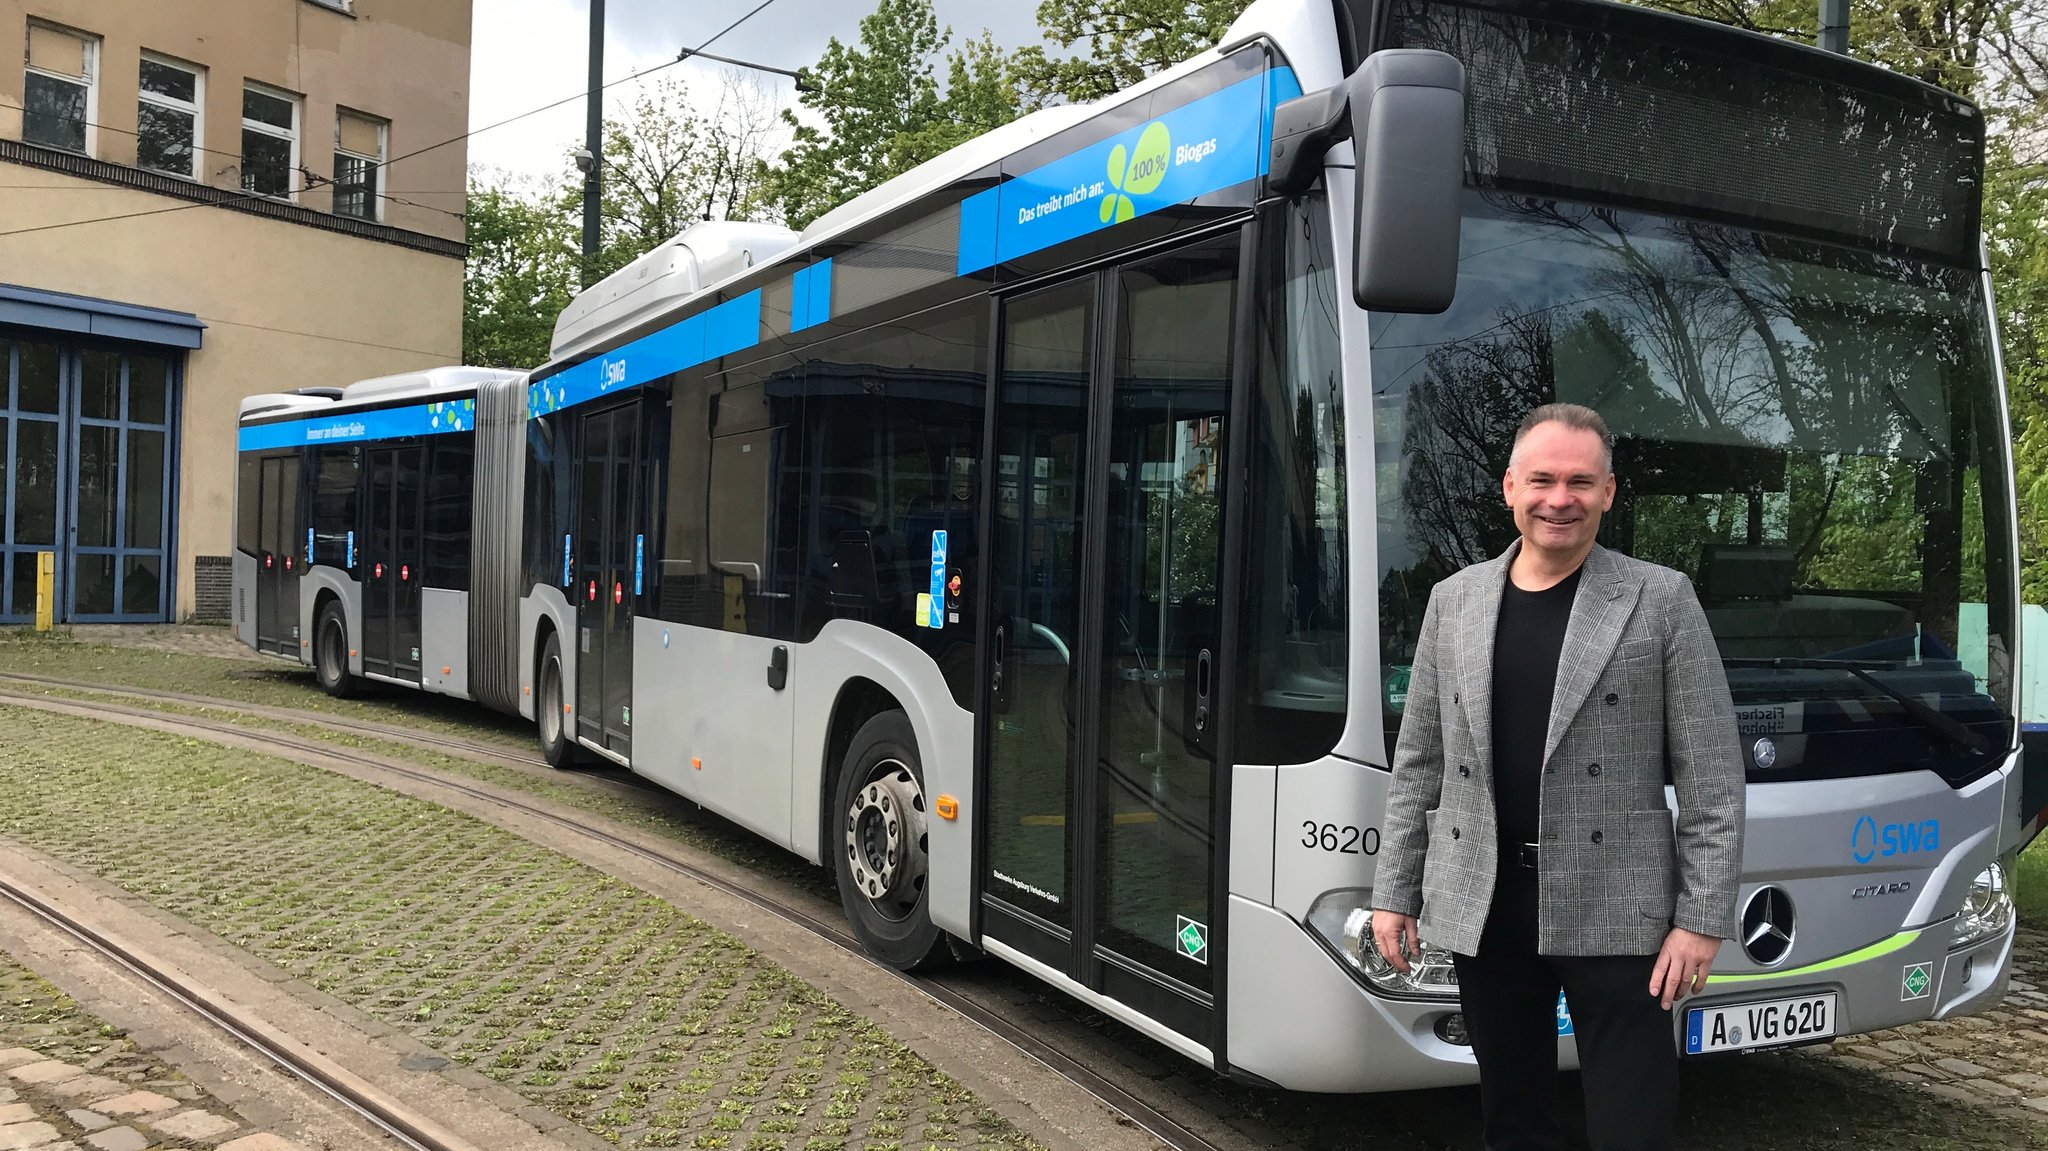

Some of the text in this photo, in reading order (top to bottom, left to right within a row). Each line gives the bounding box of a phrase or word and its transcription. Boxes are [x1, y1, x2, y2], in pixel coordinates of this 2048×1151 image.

[1132, 152, 1166, 181] 100 %
[1175, 138, 1217, 167] Biogas
[1018, 181, 1105, 225] Das treibt mich an:
[607, 359, 626, 386] swa
[306, 422, 366, 440] Immer an deiner Seite
[1397, 676, 1406, 693] 4
[1301, 820, 1381, 856] 3620
[1880, 818, 1940, 858] swa
[993, 869, 1060, 904] Stadtwerke Augsburg Verkehrs-GmbH
[1852, 881, 1912, 899] CITARO
[1183, 931, 1201, 948] CNG
[1909, 975, 1926, 988] CNG
[1691, 1000, 1826, 1047] D A VG 620
